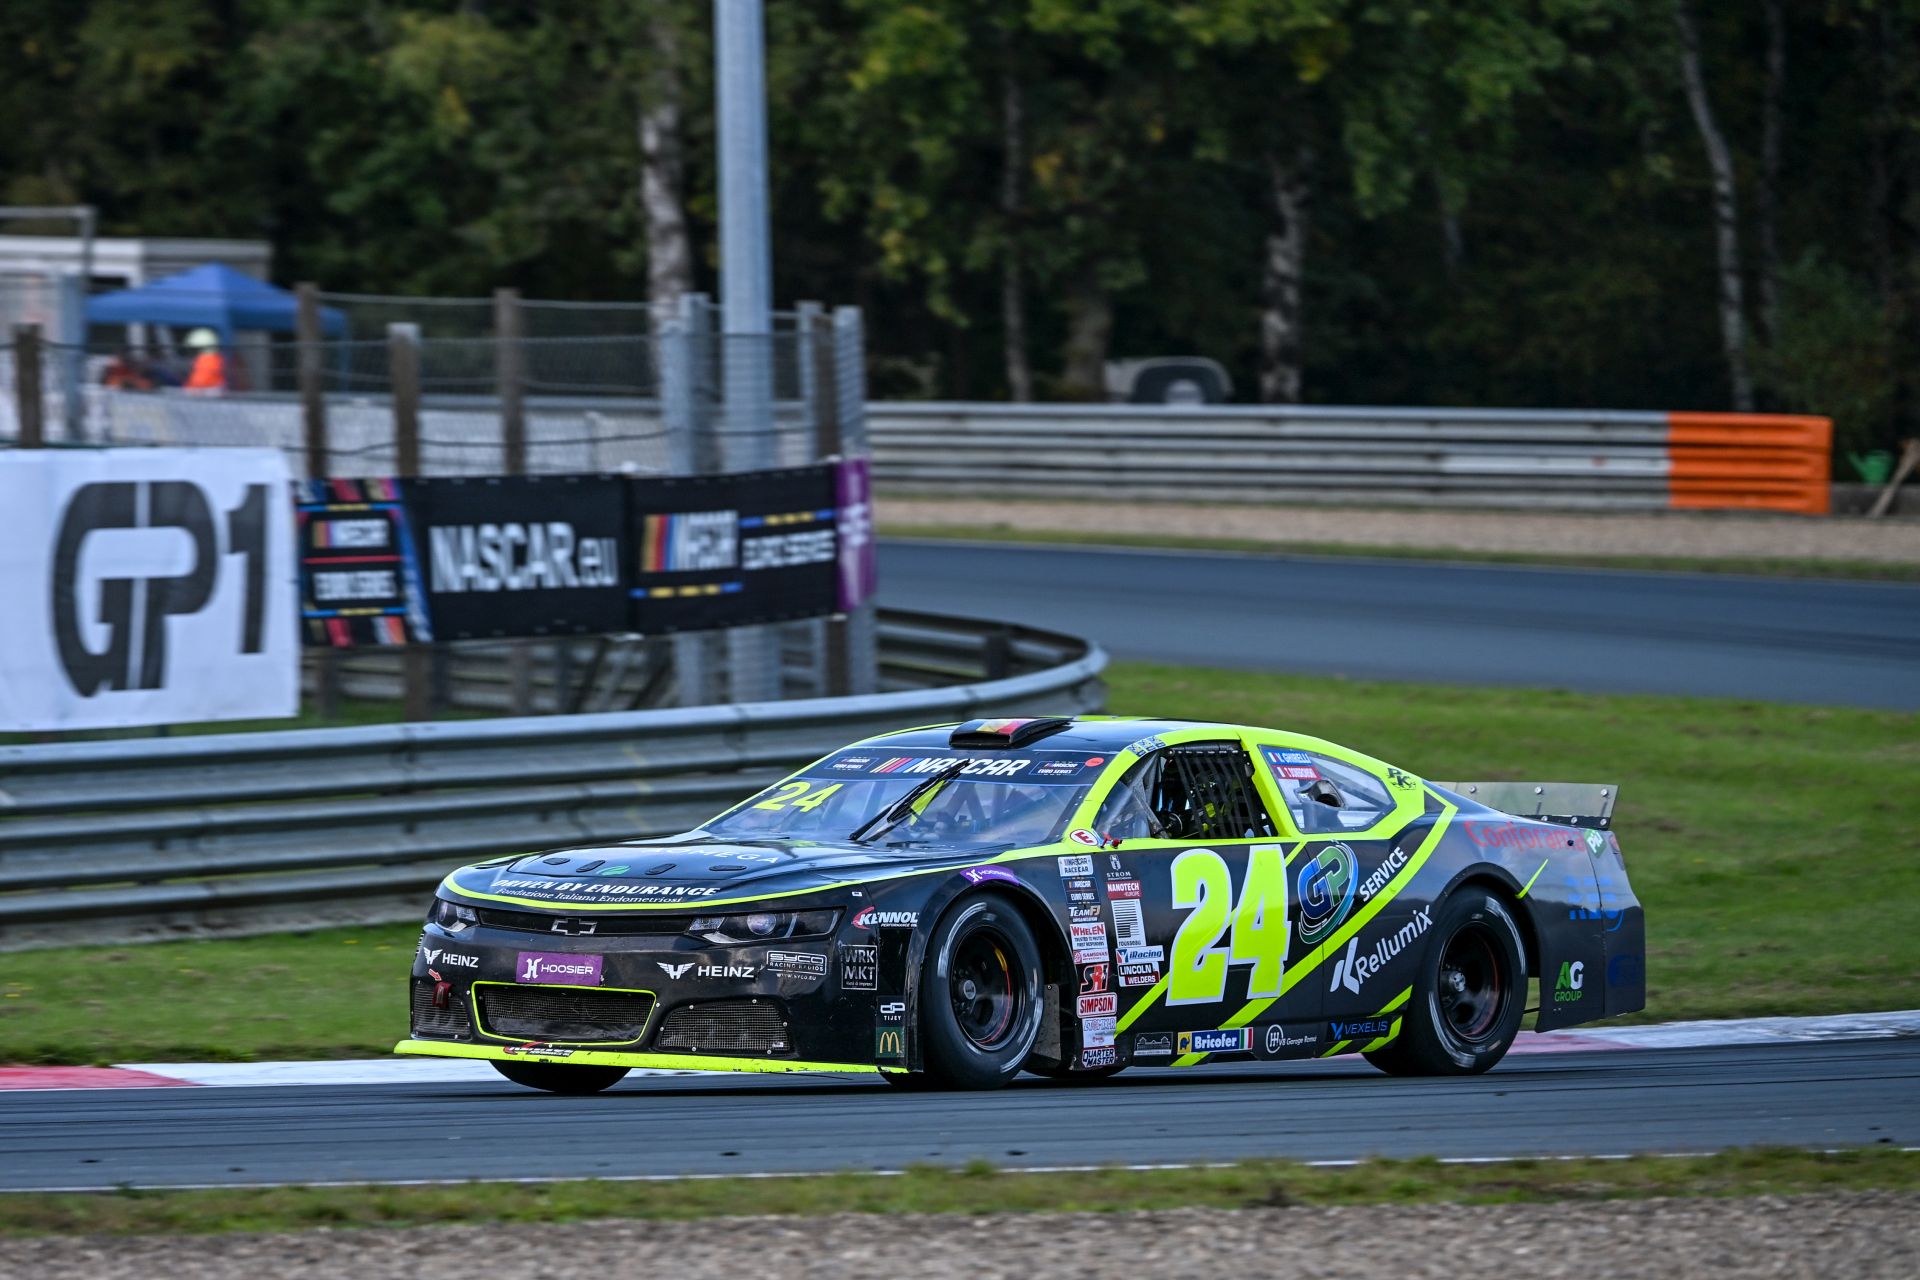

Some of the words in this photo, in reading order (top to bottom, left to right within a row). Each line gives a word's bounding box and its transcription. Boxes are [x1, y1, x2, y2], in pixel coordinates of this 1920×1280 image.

[428, 520, 619, 594] NASCAR.eu
[49, 480, 272, 699] GP1
[753, 781, 844, 813] 24
[1359, 846, 1408, 902] SERVICE
[491, 879, 556, 889] DRIVEN
[554, 882, 588, 892] BY
[585, 883, 720, 896] ENDURANCE
[1107, 882, 1140, 892] NANOTECH
[494, 888, 555, 900] Fondazione
[553, 892, 596, 902] Italiana
[597, 896, 683, 904] Endometriosi
[858, 911, 919, 926] KENNOL
[1166, 845, 1292, 1006] 24
[1070, 923, 1105, 936] WHELEN
[1355, 904, 1433, 985] Rellumix
[442, 953, 479, 968] HEINZ
[844, 949, 875, 963] WRK
[1130, 950, 1163, 960] iRacing
[541, 964, 594, 975] HOOSIER
[697, 966, 755, 978] HEINZ
[844, 965, 875, 980] MKT
[1120, 964, 1152, 975] LINCOLN
[1554, 961, 1585, 990] AG
[1127, 975, 1156, 984] WELDERS
[1554, 990, 1583, 1002] GROUP
[1080, 996, 1114, 1014] SIMPSON
[1344, 1021, 1388, 1035] VEXELIS
[1194, 1035, 1238, 1050] Bricofer
[1082, 1049, 1114, 1062] QUARTER
